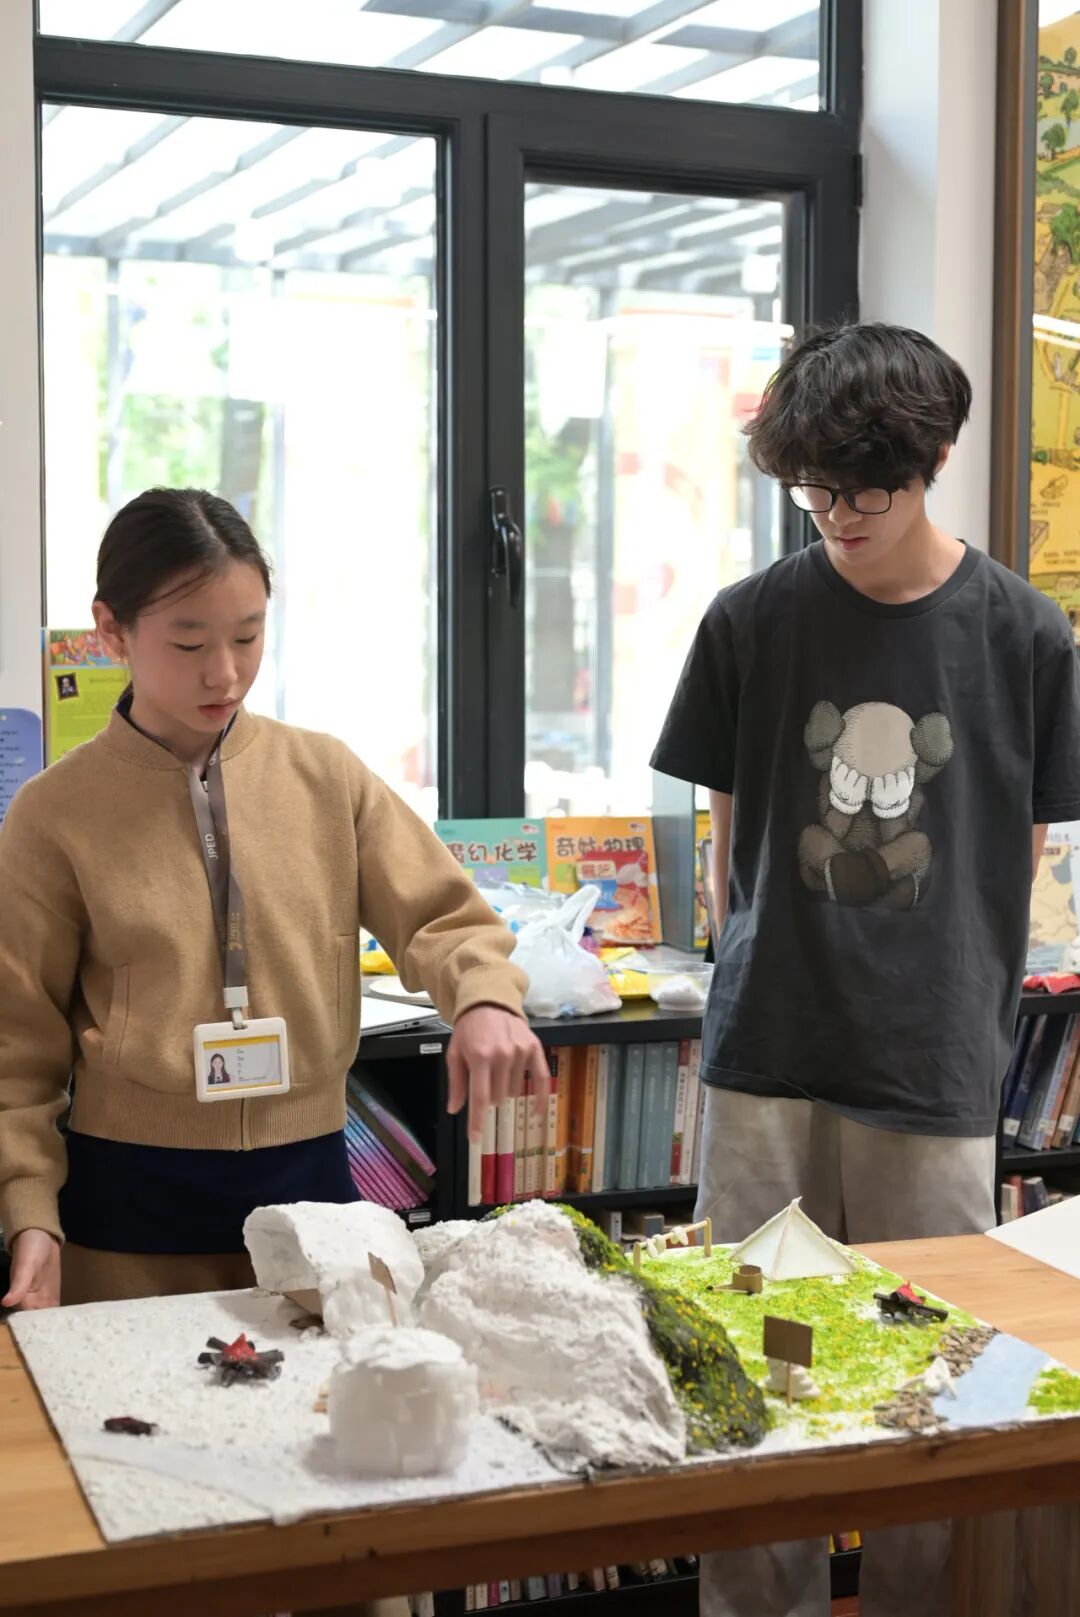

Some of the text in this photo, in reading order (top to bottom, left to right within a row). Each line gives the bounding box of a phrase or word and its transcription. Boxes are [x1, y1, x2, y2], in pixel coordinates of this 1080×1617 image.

[204, 833, 219, 860] JPED
[556, 836, 644, 857] 奇妙物理
